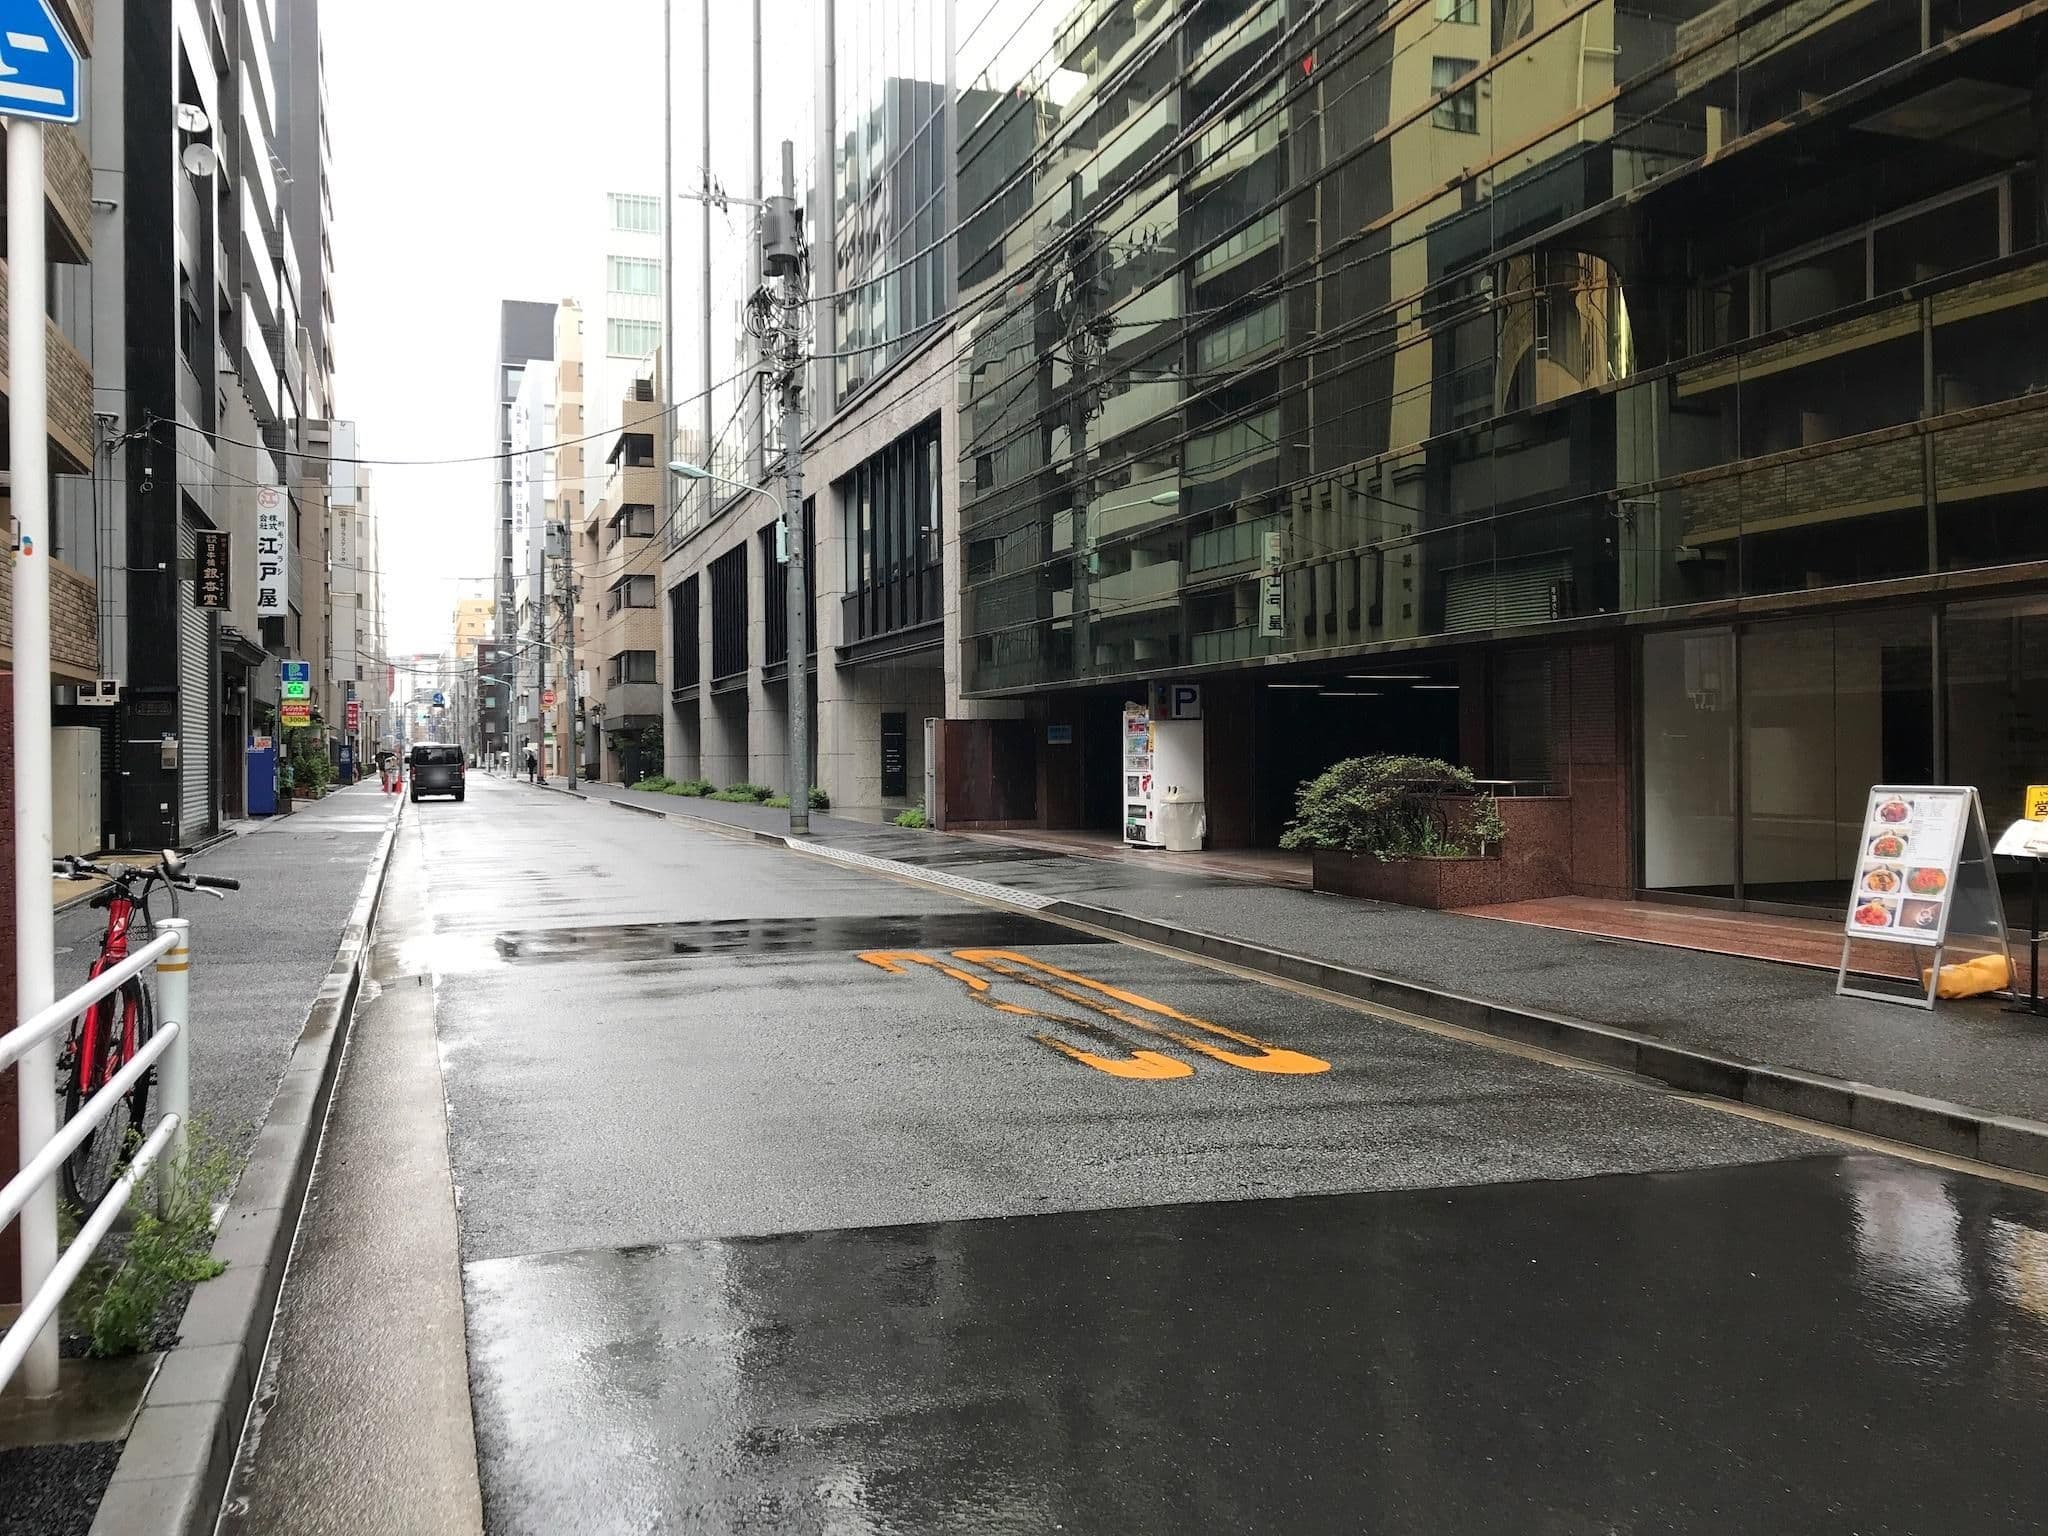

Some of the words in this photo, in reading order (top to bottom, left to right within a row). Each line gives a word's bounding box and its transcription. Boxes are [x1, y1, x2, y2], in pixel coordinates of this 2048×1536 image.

[257, 537, 279, 608] 江戸屋
[1175, 687, 1198, 716] P
[856, 949, 1332, 1081] 30
